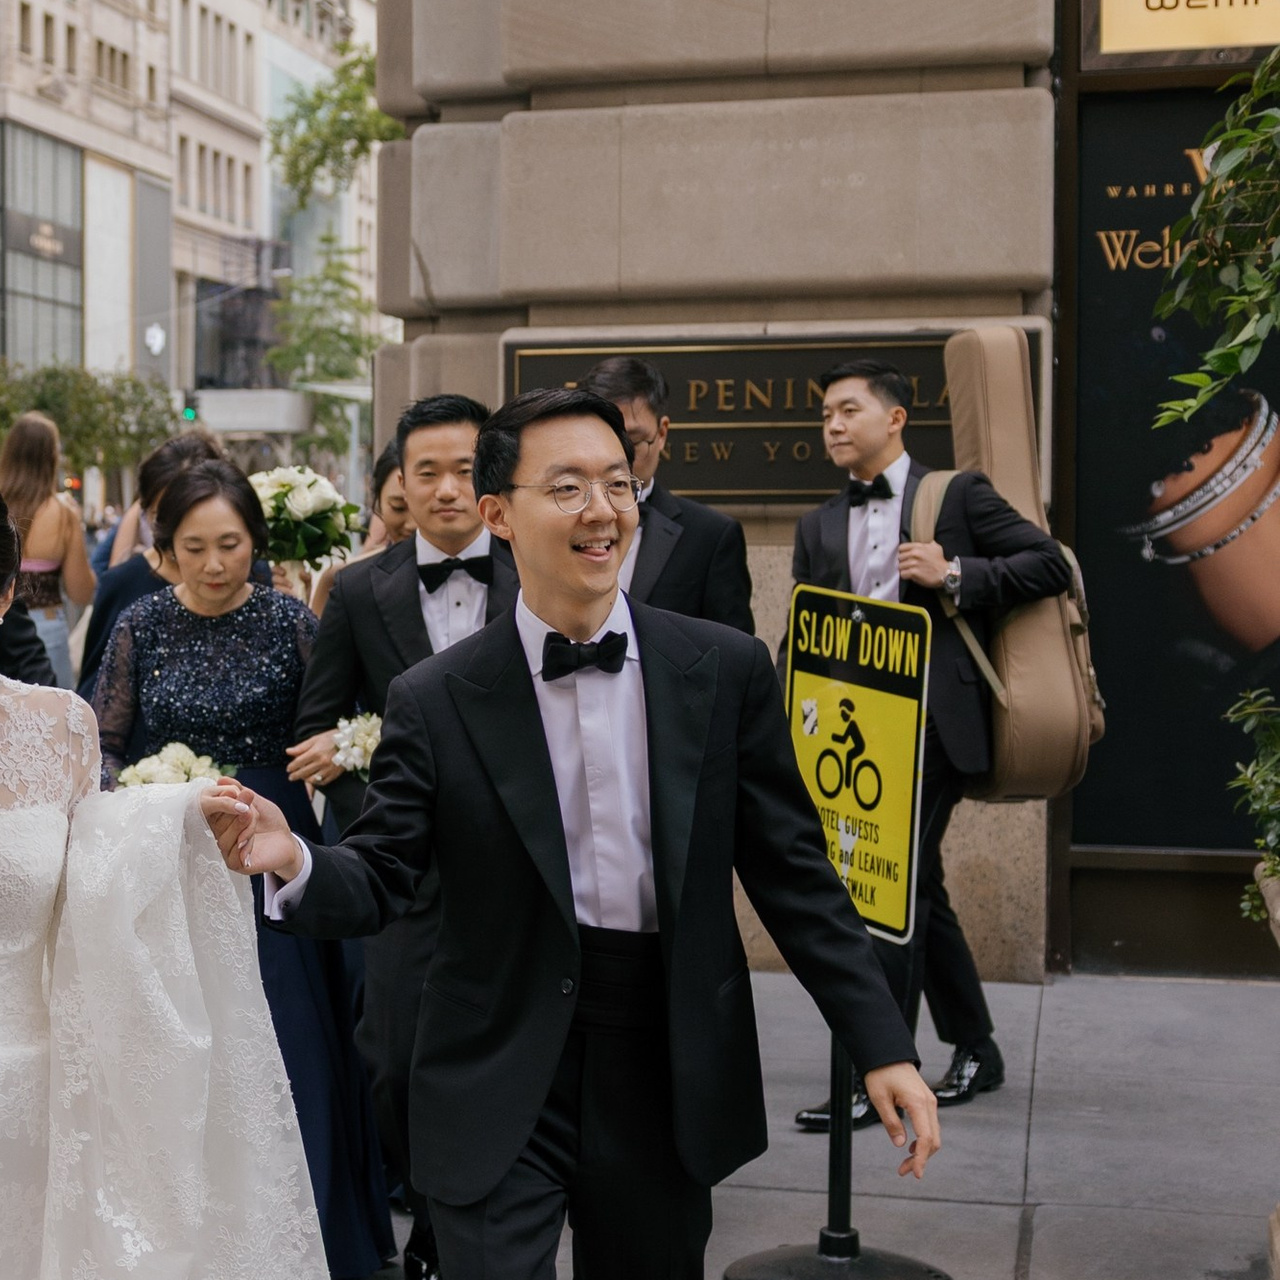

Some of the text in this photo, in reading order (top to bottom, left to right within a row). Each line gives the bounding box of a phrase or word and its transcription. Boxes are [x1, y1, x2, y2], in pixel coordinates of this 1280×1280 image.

[1105, 182, 1193, 199] WAHRE
[763, 440, 830, 462] YO
[797, 609, 920, 678] SLOW DOWN
[817, 805, 880, 845] OTEL GUESTS
[838, 847, 855, 868] and
[858, 850, 899, 883] LEAVING
